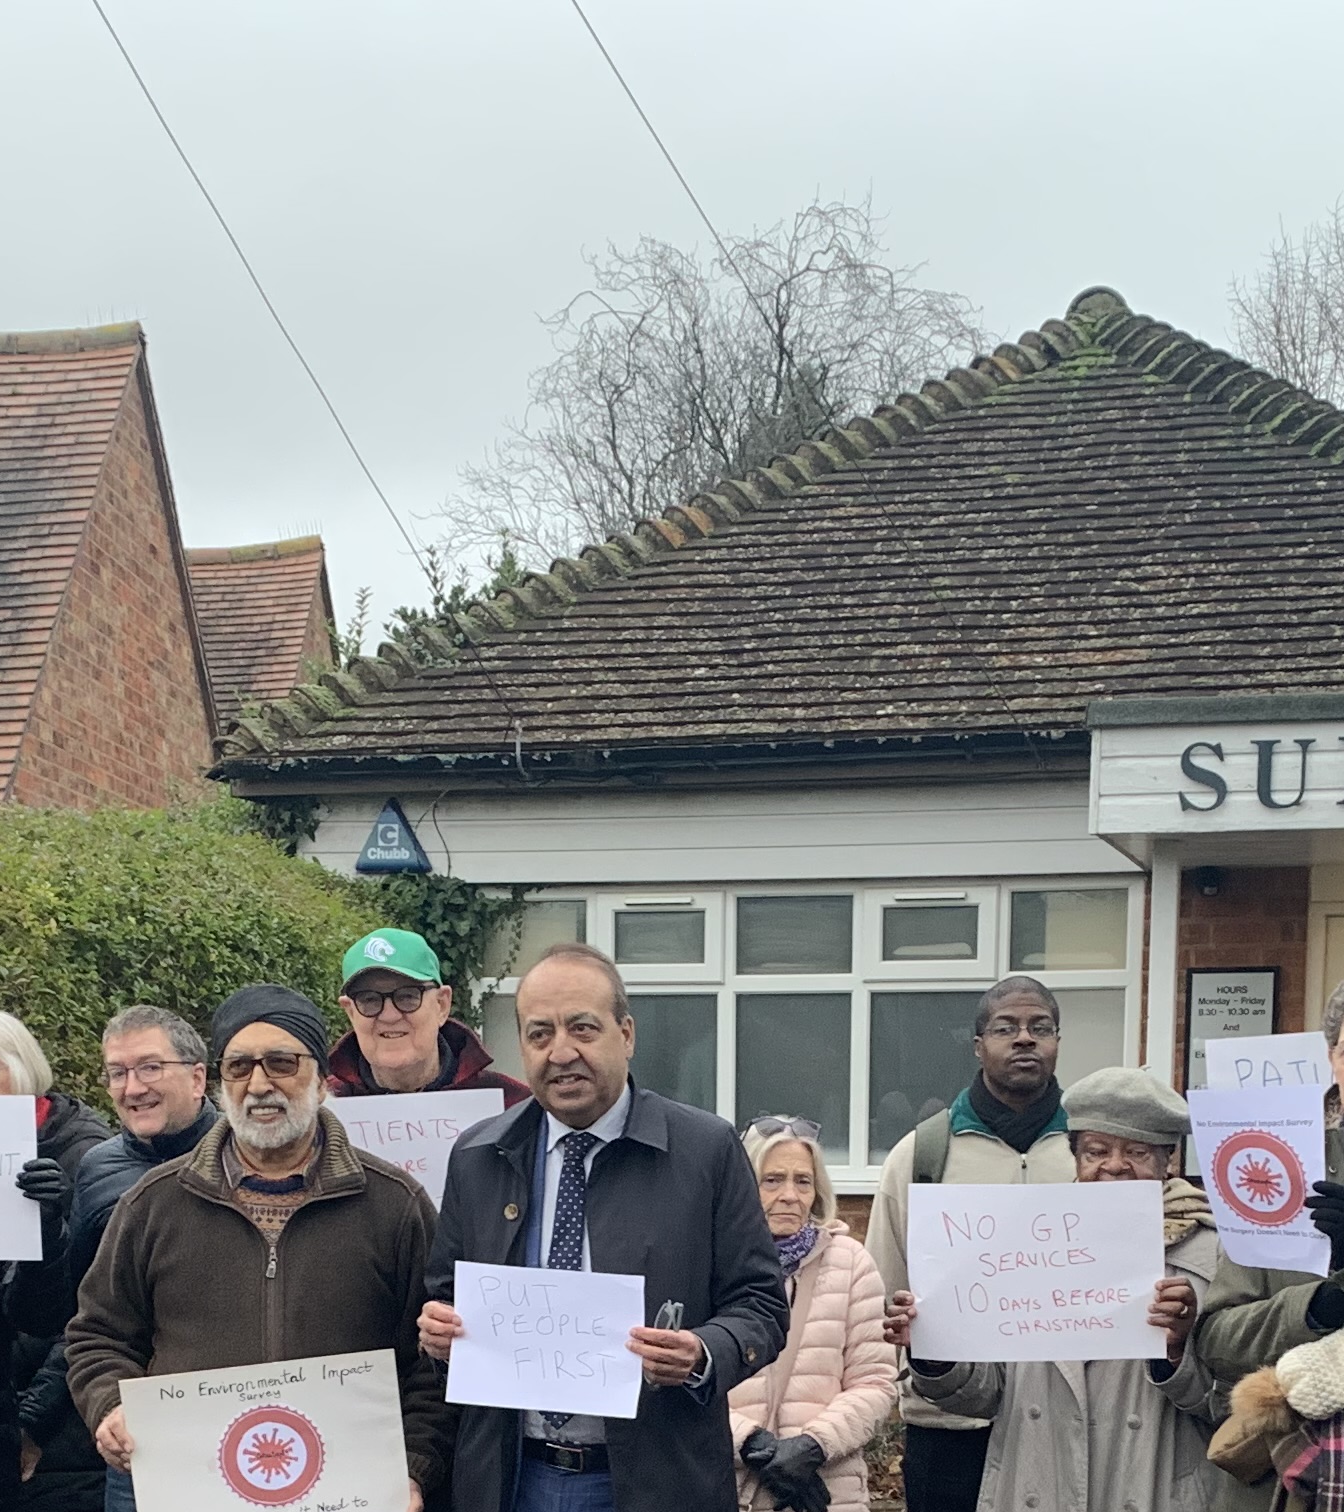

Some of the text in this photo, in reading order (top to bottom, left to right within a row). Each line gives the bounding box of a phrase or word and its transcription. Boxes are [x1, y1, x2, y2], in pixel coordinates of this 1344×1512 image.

[367, 847, 410, 860] Chubb
[1198, 997, 1230, 1006] Monday
[1240, 996, 1266, 1006] Friday
[1217, 985, 1248, 994] HOURS
[1228, 1008, 1250, 1016] 10.30
[1223, 1023, 1240, 1031] And
[1235, 1058, 1334, 1088] PATI
[350, 1118, 460, 1148] TIENTS
[1196, 1118, 1314, 1128] No Environmental Impact Survey
[941, 1211, 996, 1247] NO
[978, 1246, 1097, 1278] SERVICES
[478, 1275, 558, 1314] PUT
[954, 1281, 1132, 1314] 10 DAYS BEFORE
[490, 1311, 607, 1337] PEOPLE
[513, 1346, 617, 1388] FIRST
[159, 1360, 374, 1401] No Environmental Impact
[239, 1388, 282, 1402] Survey
[352, 1495, 369, 1509] to
